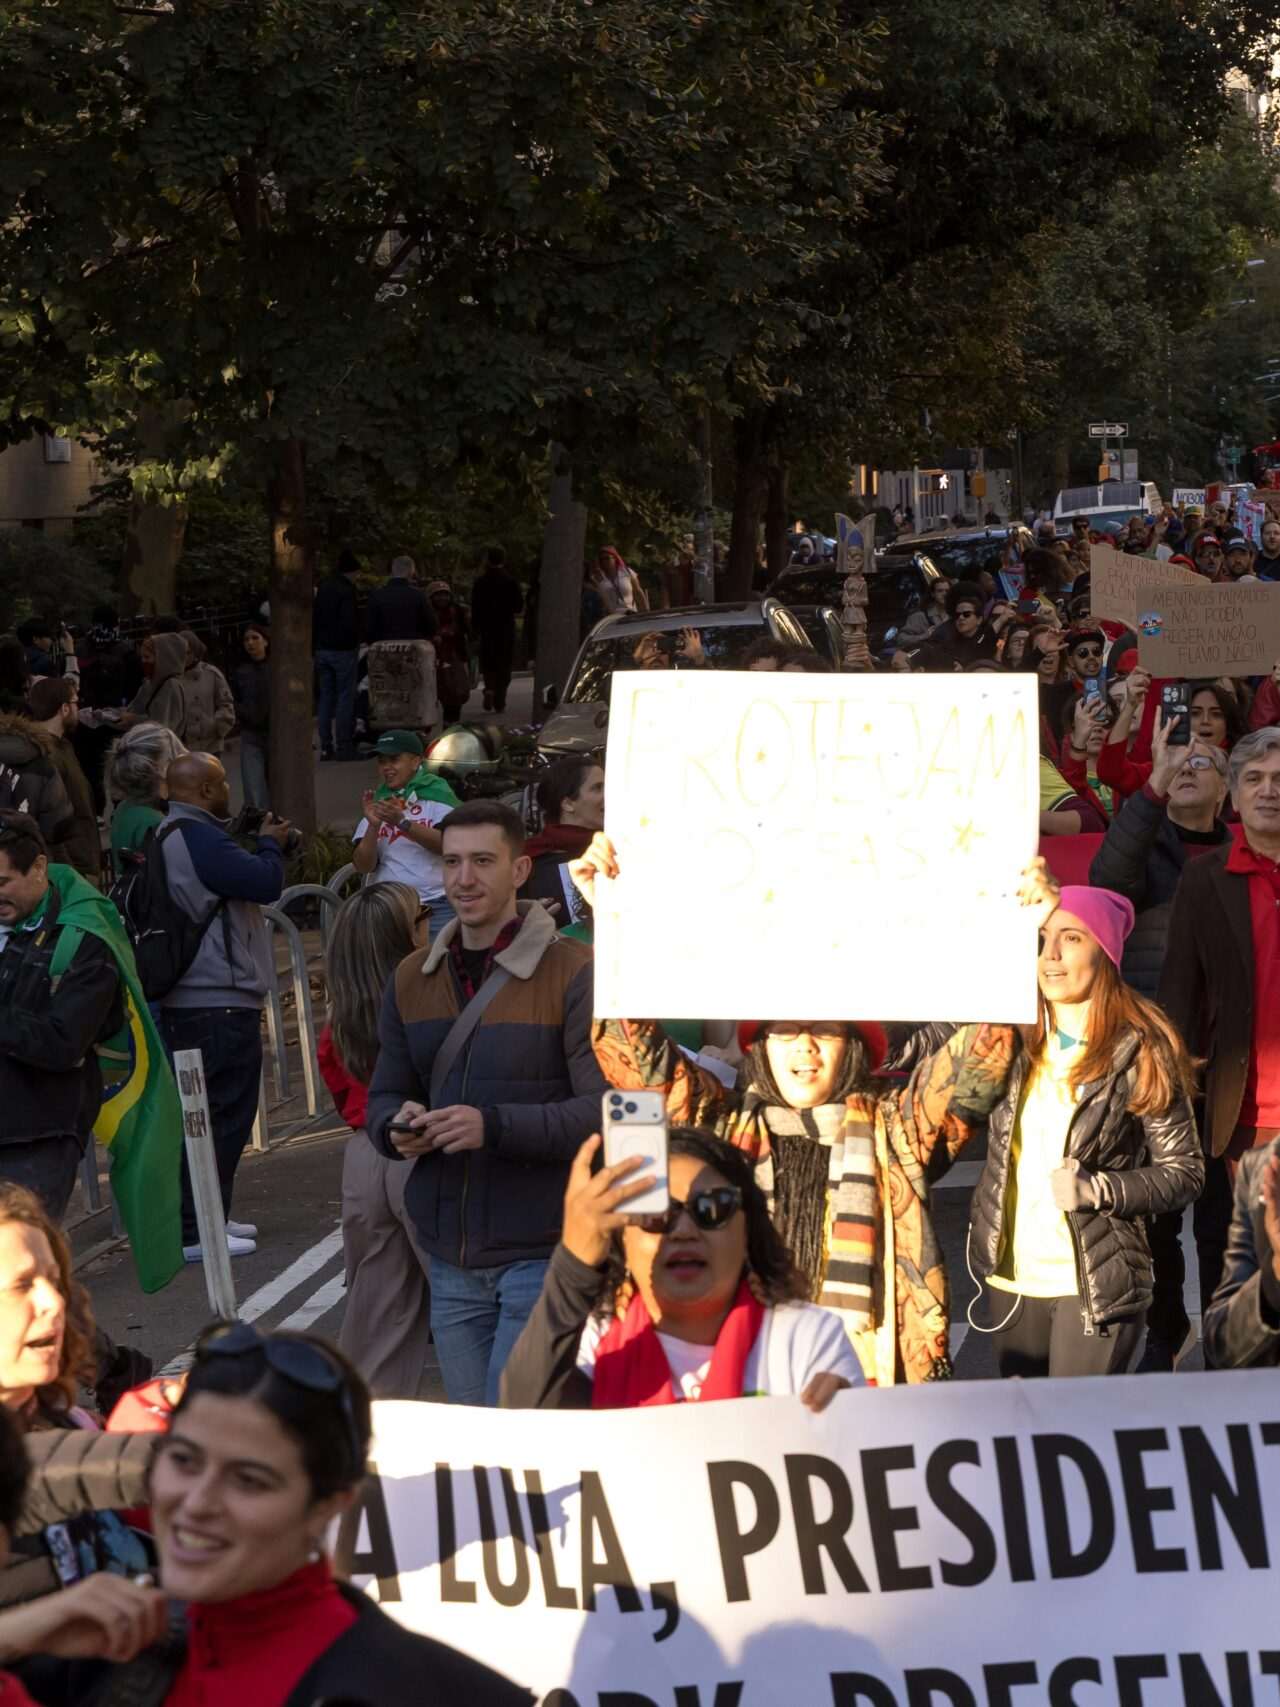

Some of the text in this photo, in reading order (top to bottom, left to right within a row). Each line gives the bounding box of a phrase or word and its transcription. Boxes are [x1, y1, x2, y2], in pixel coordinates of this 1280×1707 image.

[1152, 590, 1215, 608] MENINOS
[1205, 607, 1243, 624] PODEM
[434, 1462, 680, 1642] LULA,
